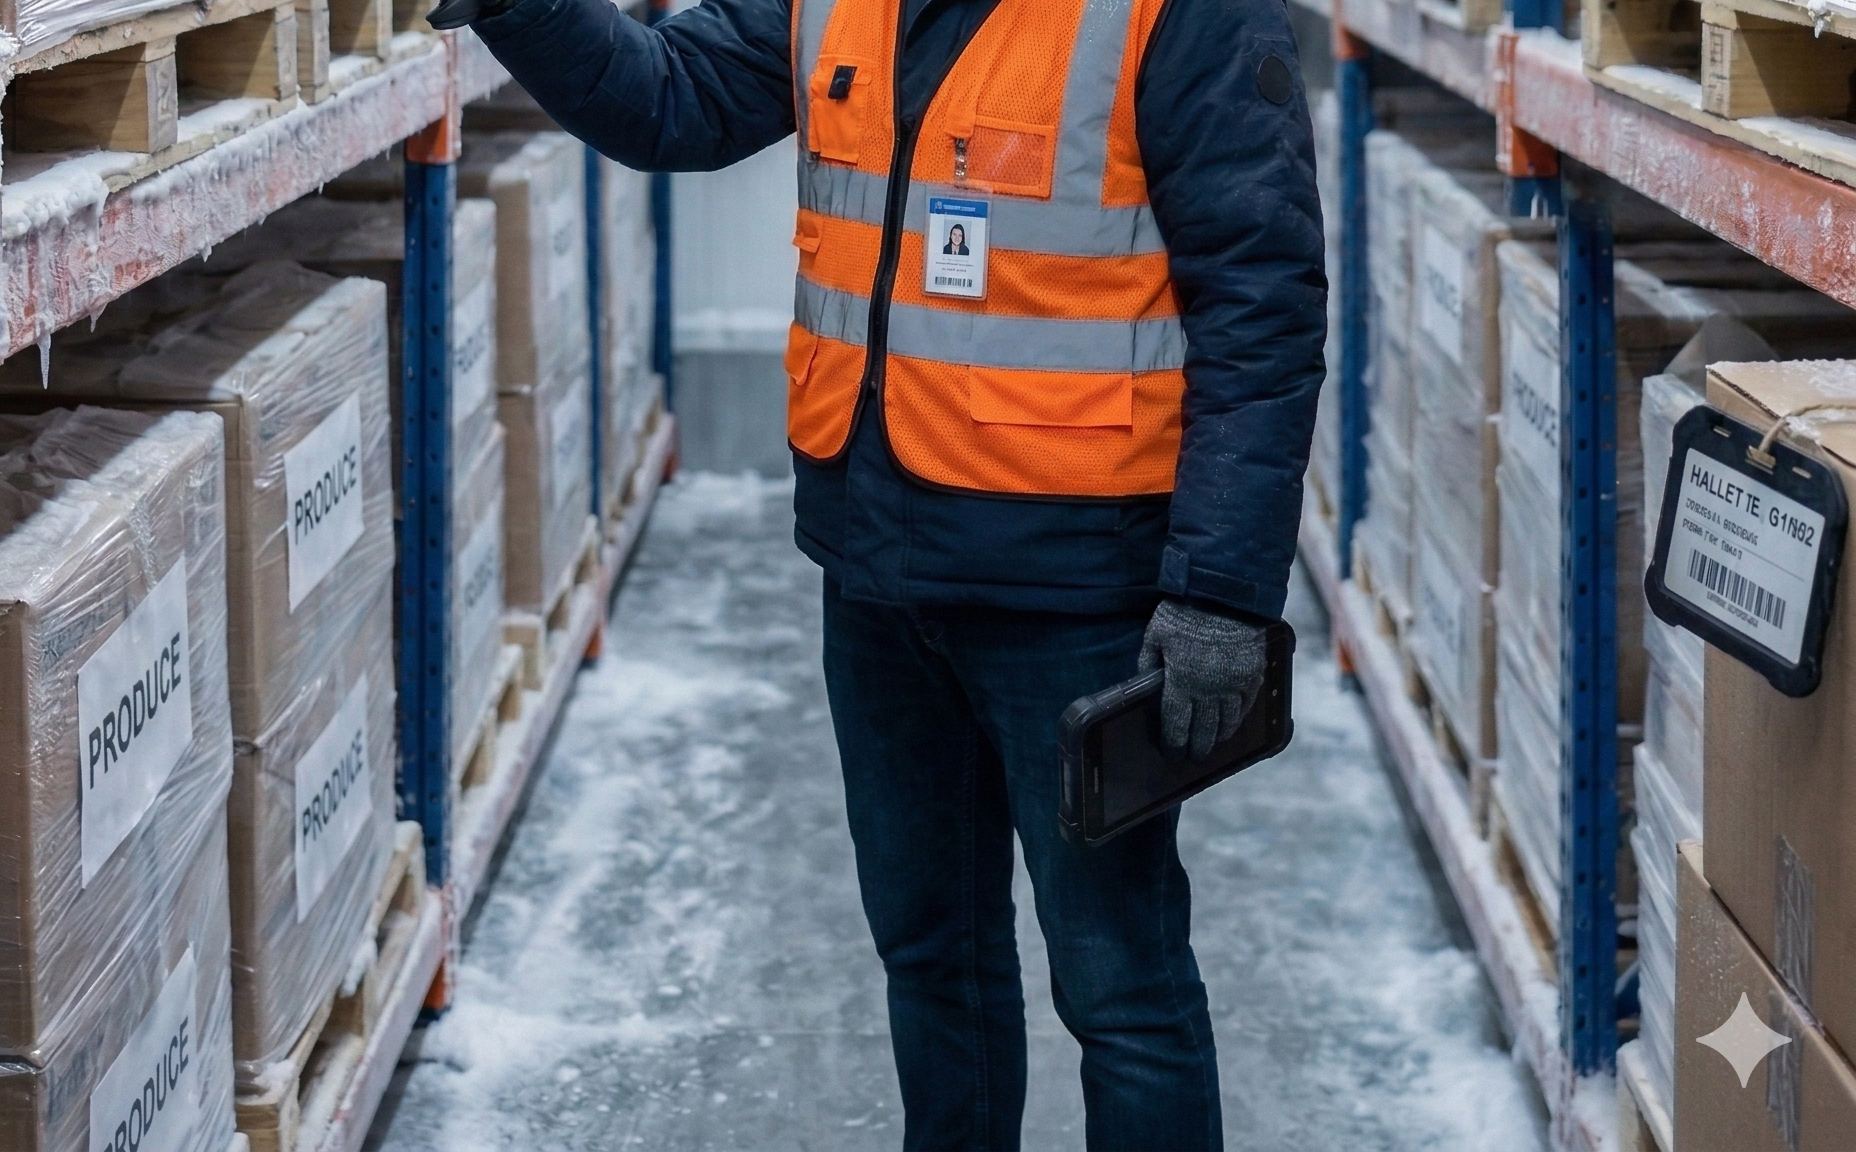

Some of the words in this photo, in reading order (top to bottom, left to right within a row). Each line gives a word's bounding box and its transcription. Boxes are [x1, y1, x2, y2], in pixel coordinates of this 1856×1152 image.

[295, 444, 357, 546] PRODUCE
[88, 631, 182, 791] PRODUCE
[302, 728, 363, 853] PRODUCE
[103, 1014, 189, 1152] RODUCE
